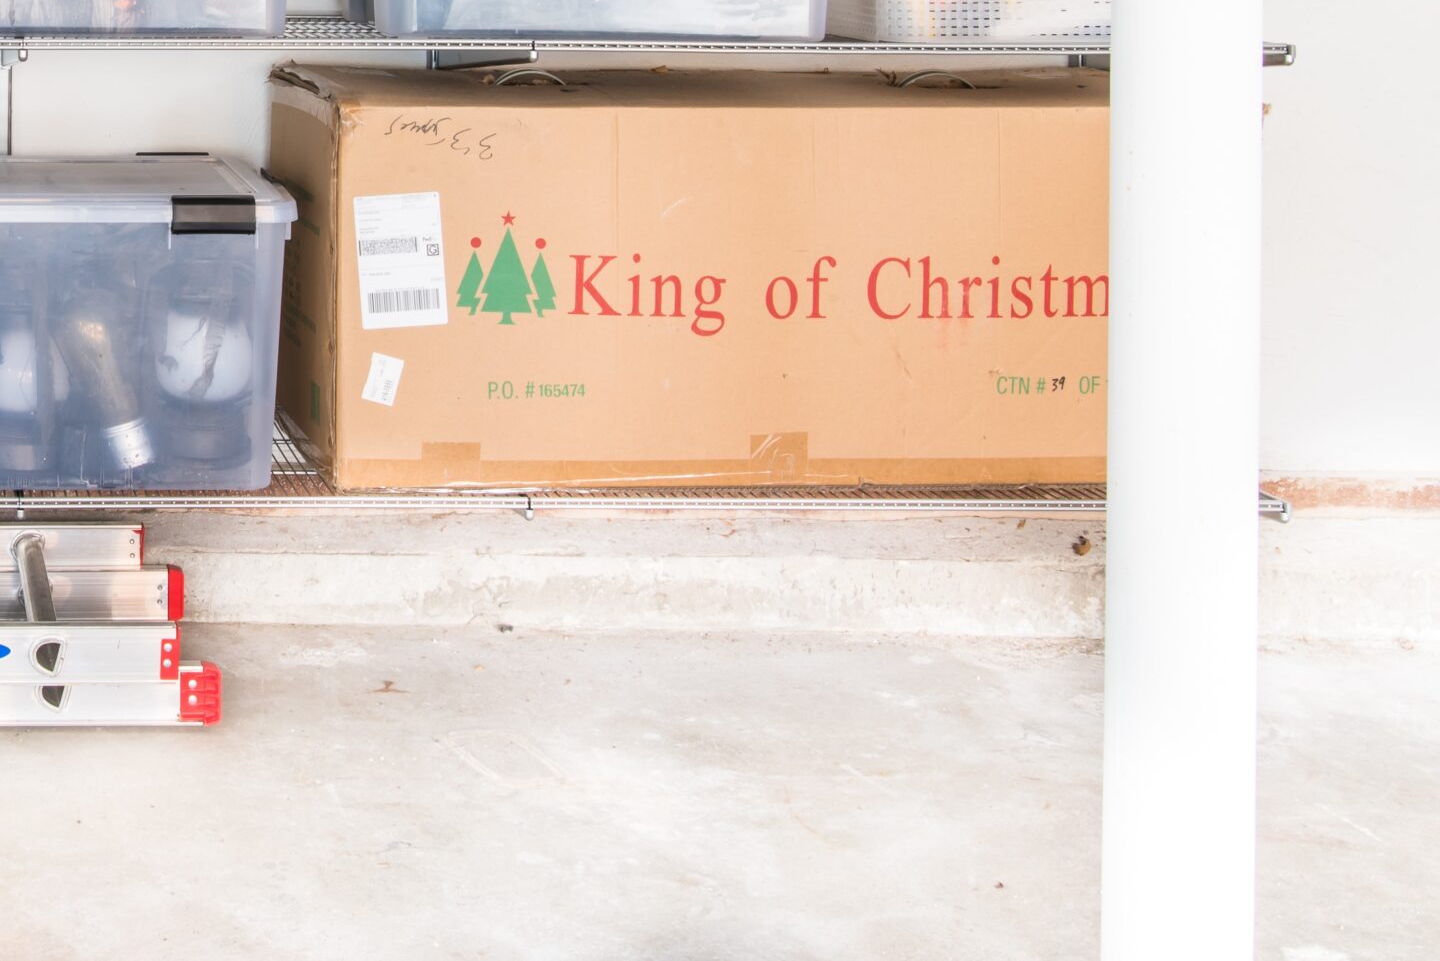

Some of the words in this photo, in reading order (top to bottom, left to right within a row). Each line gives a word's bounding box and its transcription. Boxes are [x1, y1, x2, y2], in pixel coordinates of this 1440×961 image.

[567, 253, 727, 336] King
[765, 255, 837, 320] of
[487, 380, 519, 399] P.O.
[996, 376, 1031, 395] CTN
[1079, 376, 1101, 395] OF
